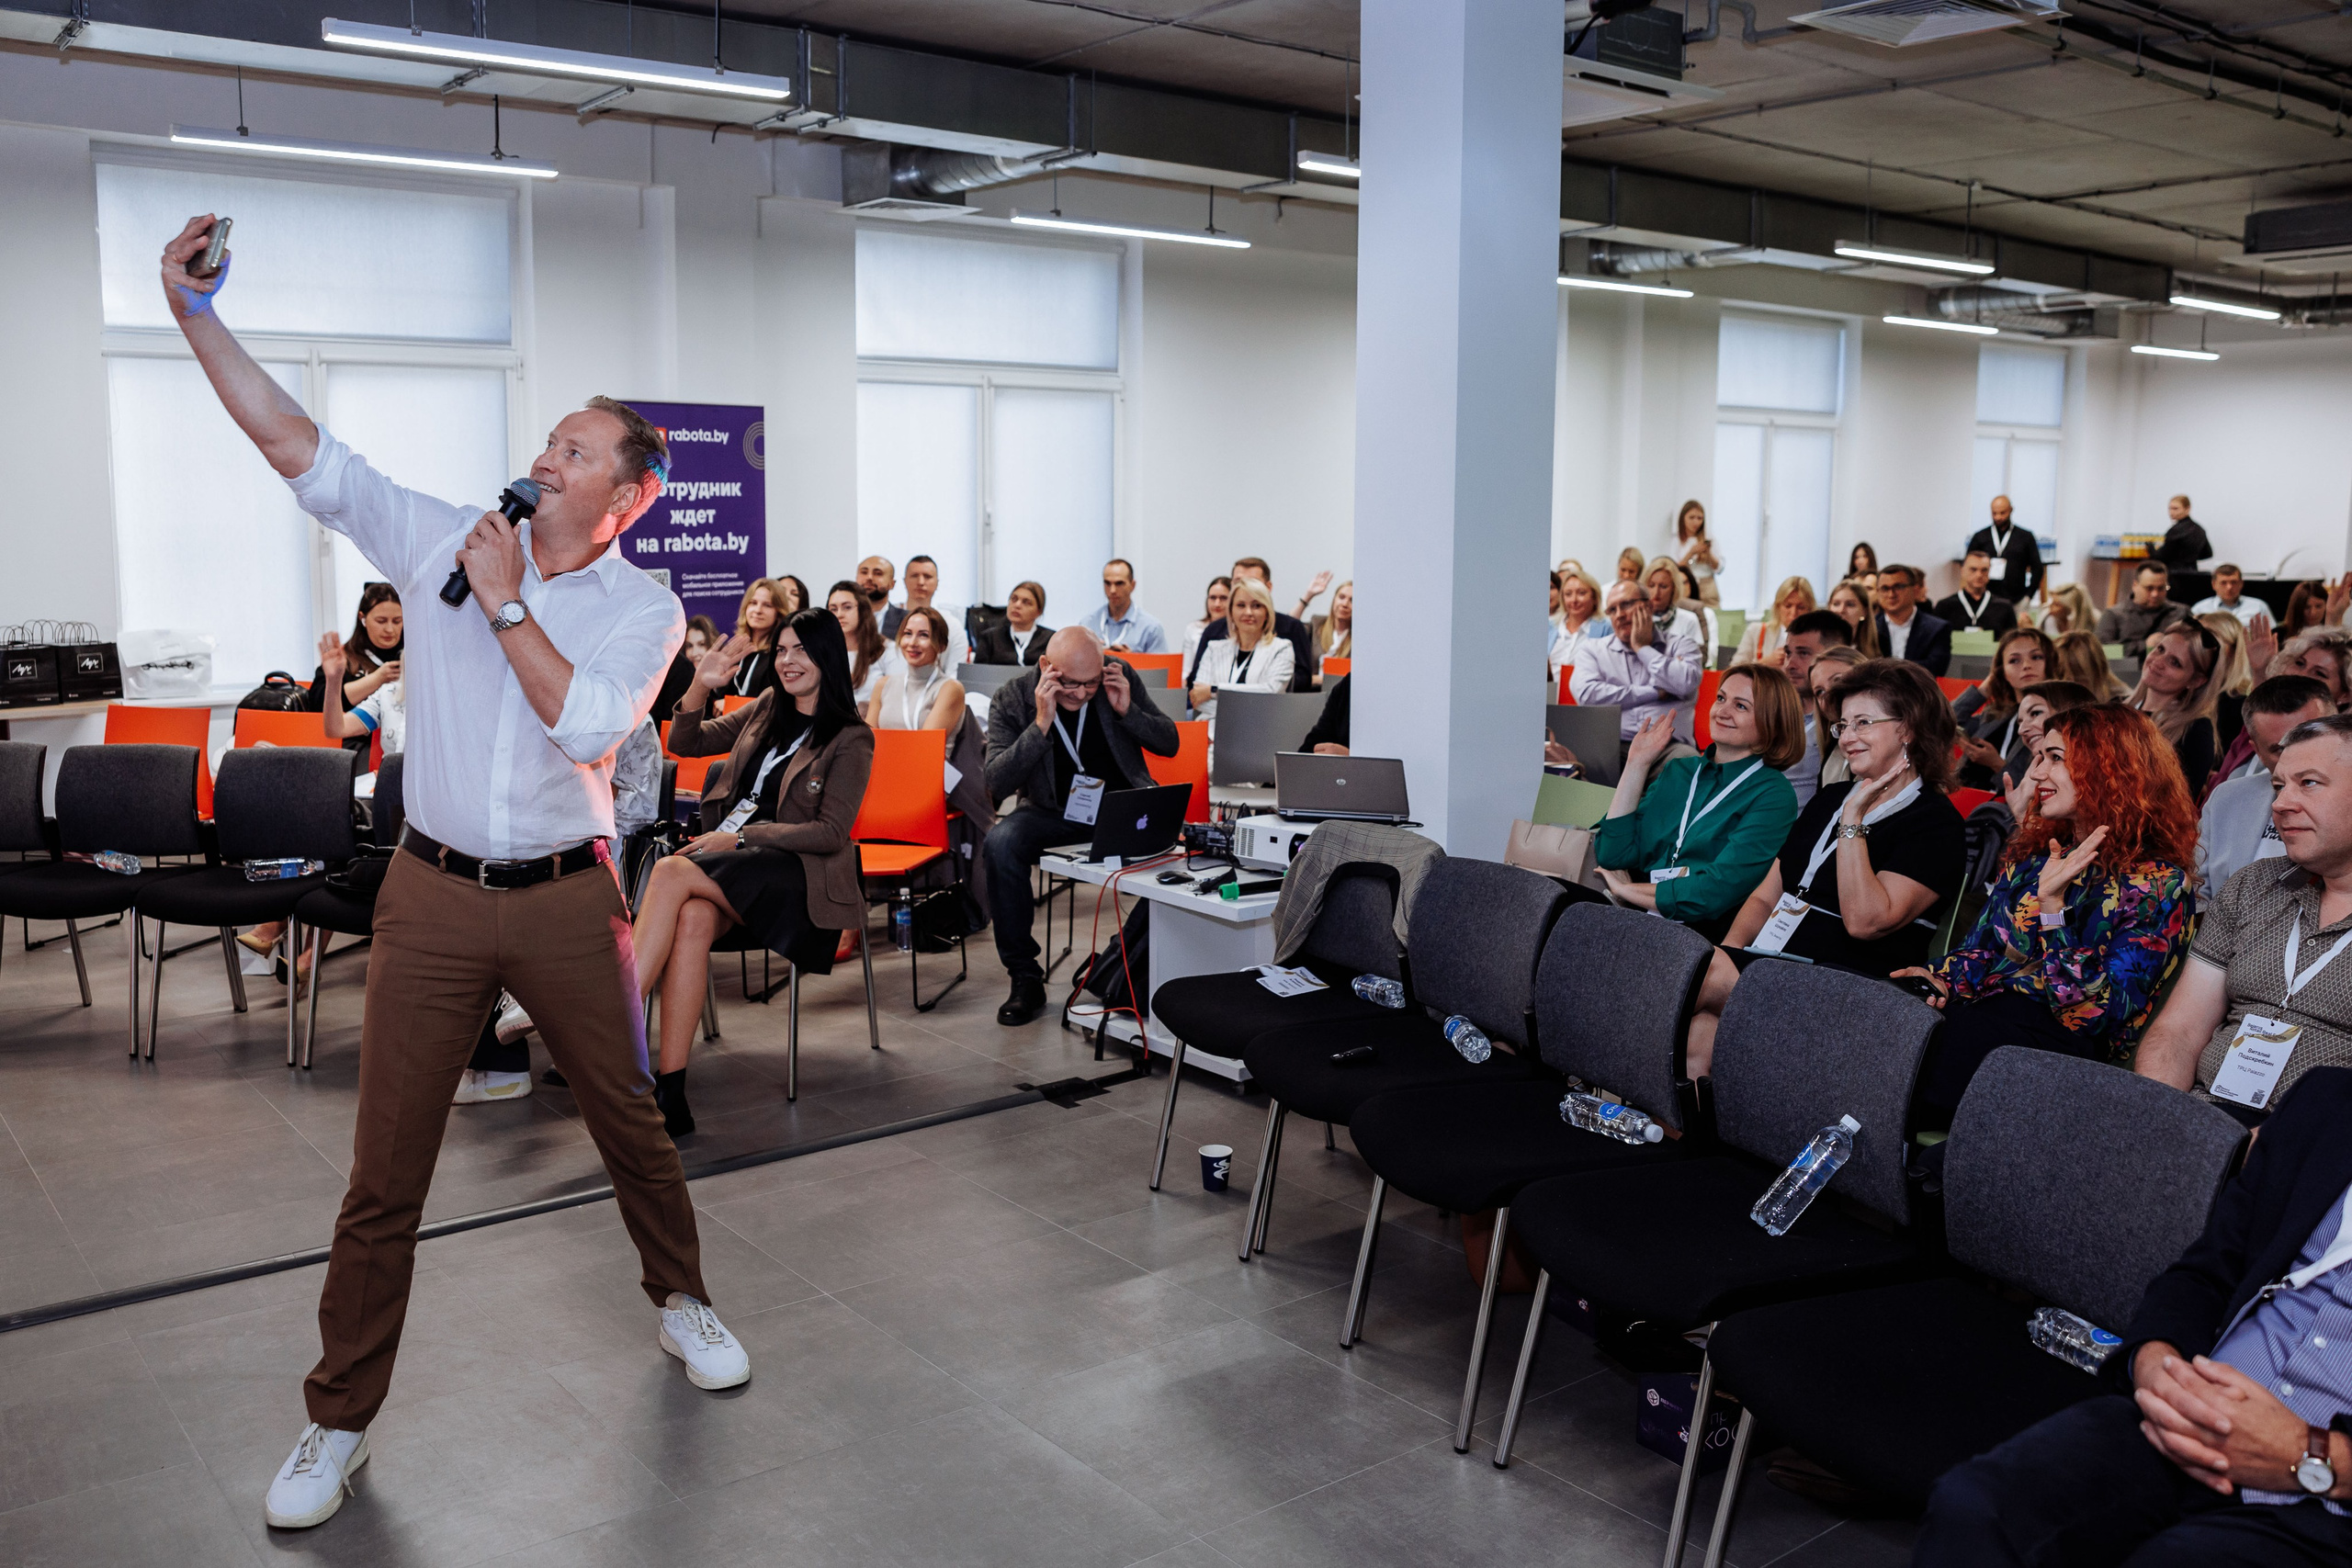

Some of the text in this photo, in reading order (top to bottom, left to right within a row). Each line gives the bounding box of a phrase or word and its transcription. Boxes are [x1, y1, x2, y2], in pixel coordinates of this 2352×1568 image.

[668, 427, 729, 446] rabota.by
[658, 481, 742, 502] отрудник
[670, 508, 717, 527] ждет
[636, 532, 750, 555] на rabota.by
